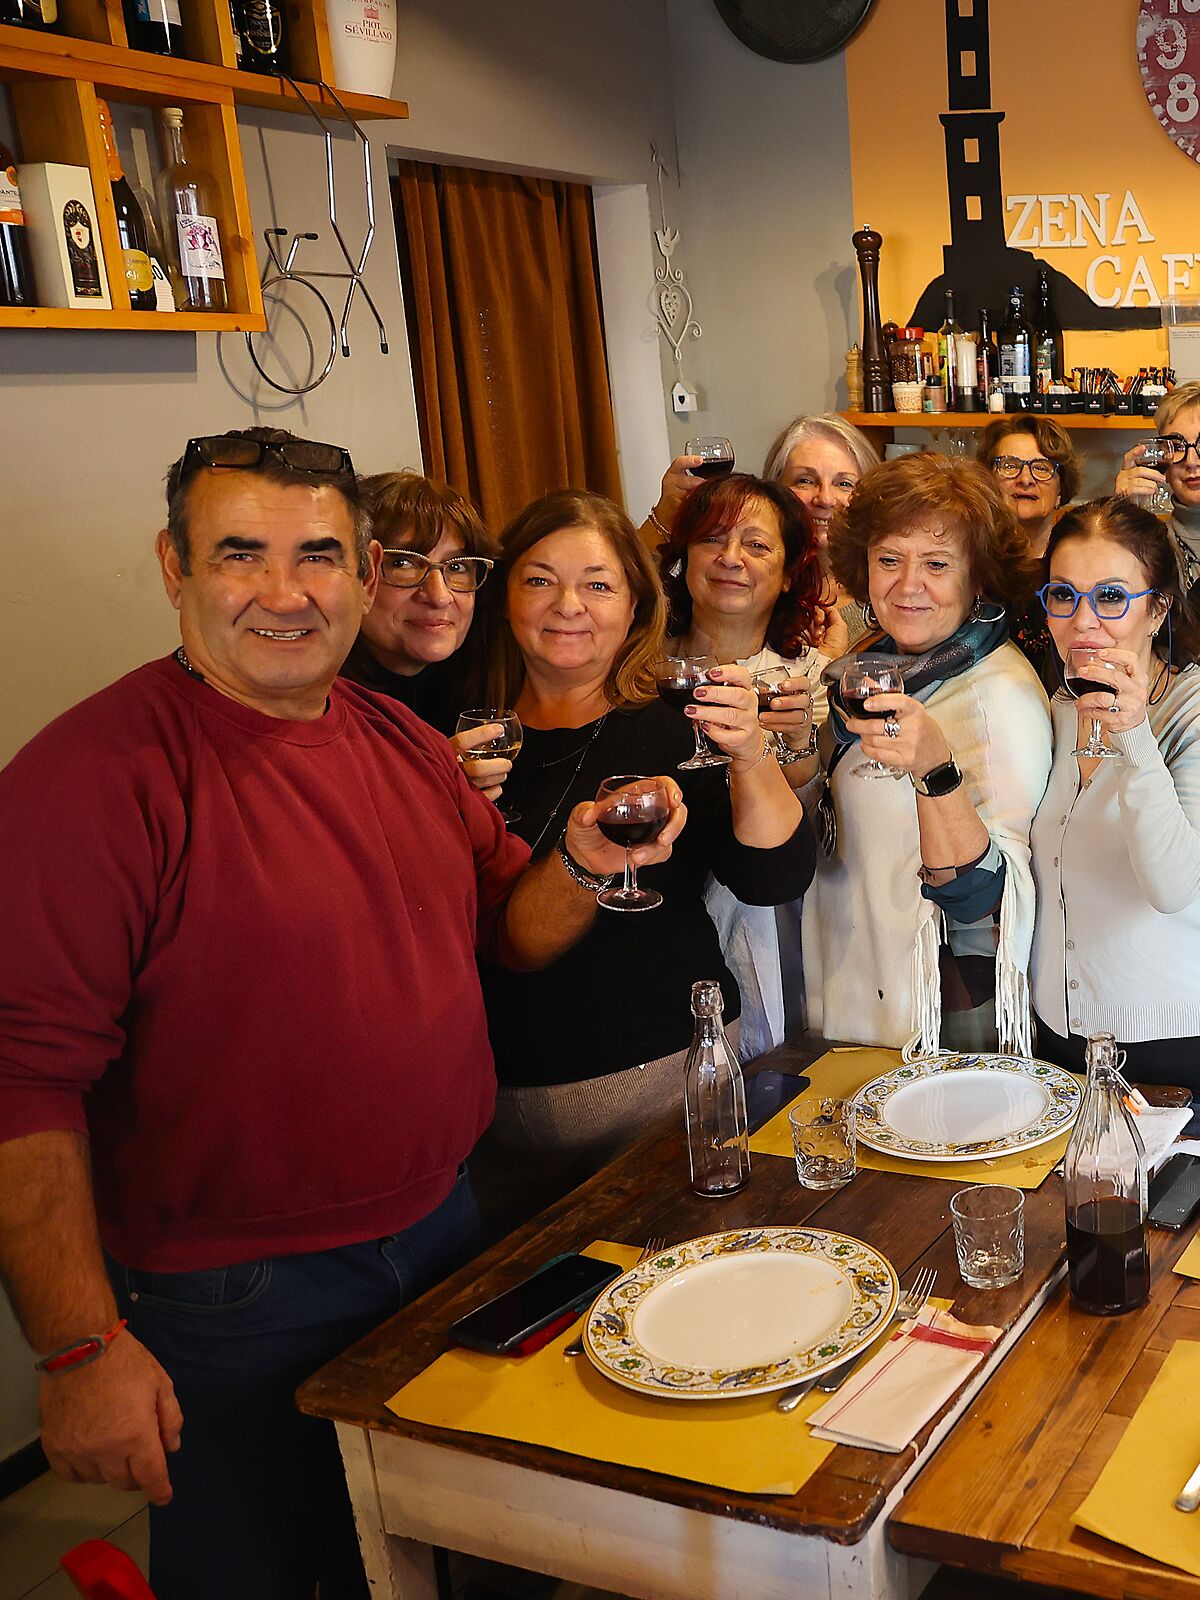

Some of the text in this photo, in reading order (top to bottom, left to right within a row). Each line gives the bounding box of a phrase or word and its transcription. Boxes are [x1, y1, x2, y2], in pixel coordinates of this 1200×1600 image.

[362, 19, 381, 30] PIOT
[1155, 18, 1188, 69] 9
[1166, 73, 1199, 122] 8
[1006, 190, 1157, 248] ZENA
